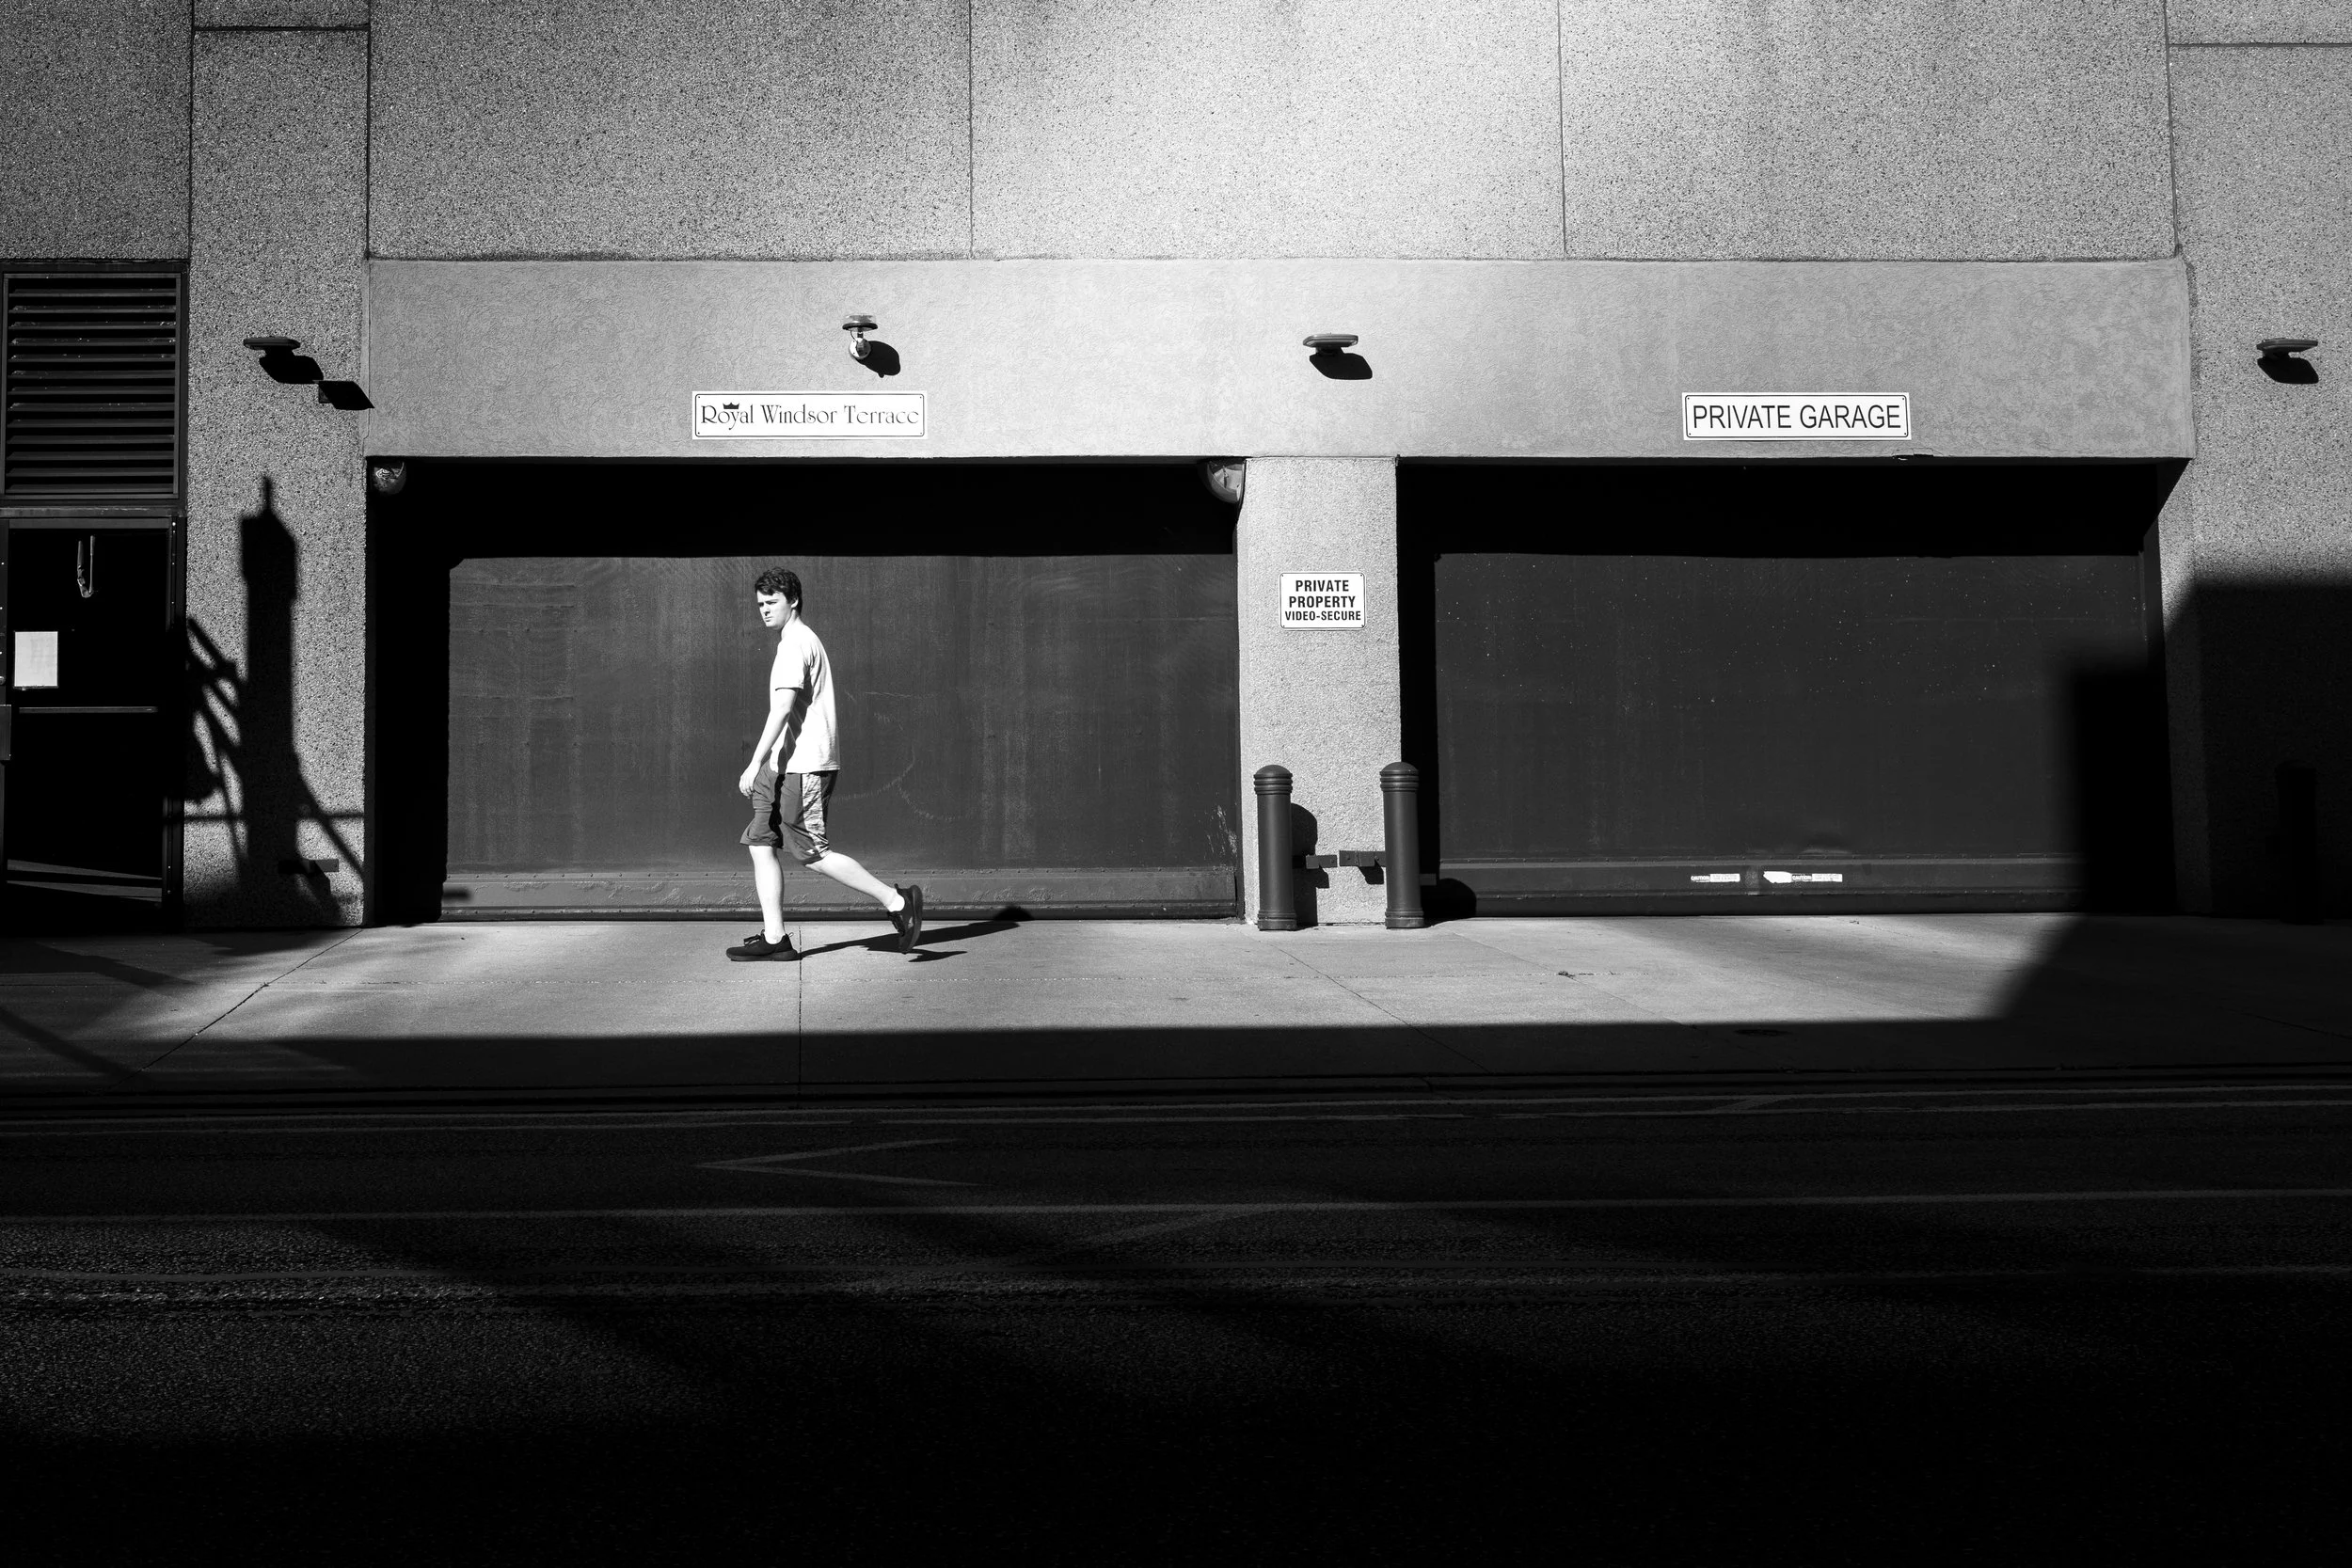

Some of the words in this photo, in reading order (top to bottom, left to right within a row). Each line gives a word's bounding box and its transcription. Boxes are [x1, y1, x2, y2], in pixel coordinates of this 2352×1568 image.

[701, 404, 755, 430] Royal
[760, 403, 837, 424] Windsor
[843, 404, 919, 424] Terrace
[1692, 404, 1792, 429] PRIVATE
[1799, 404, 1901, 429] GARAGE
[1295, 579, 1349, 592] PRIVATE
[1289, 595, 1356, 608] PROPERTY
[1285, 610, 1361, 621] VIDEO-SECURE
